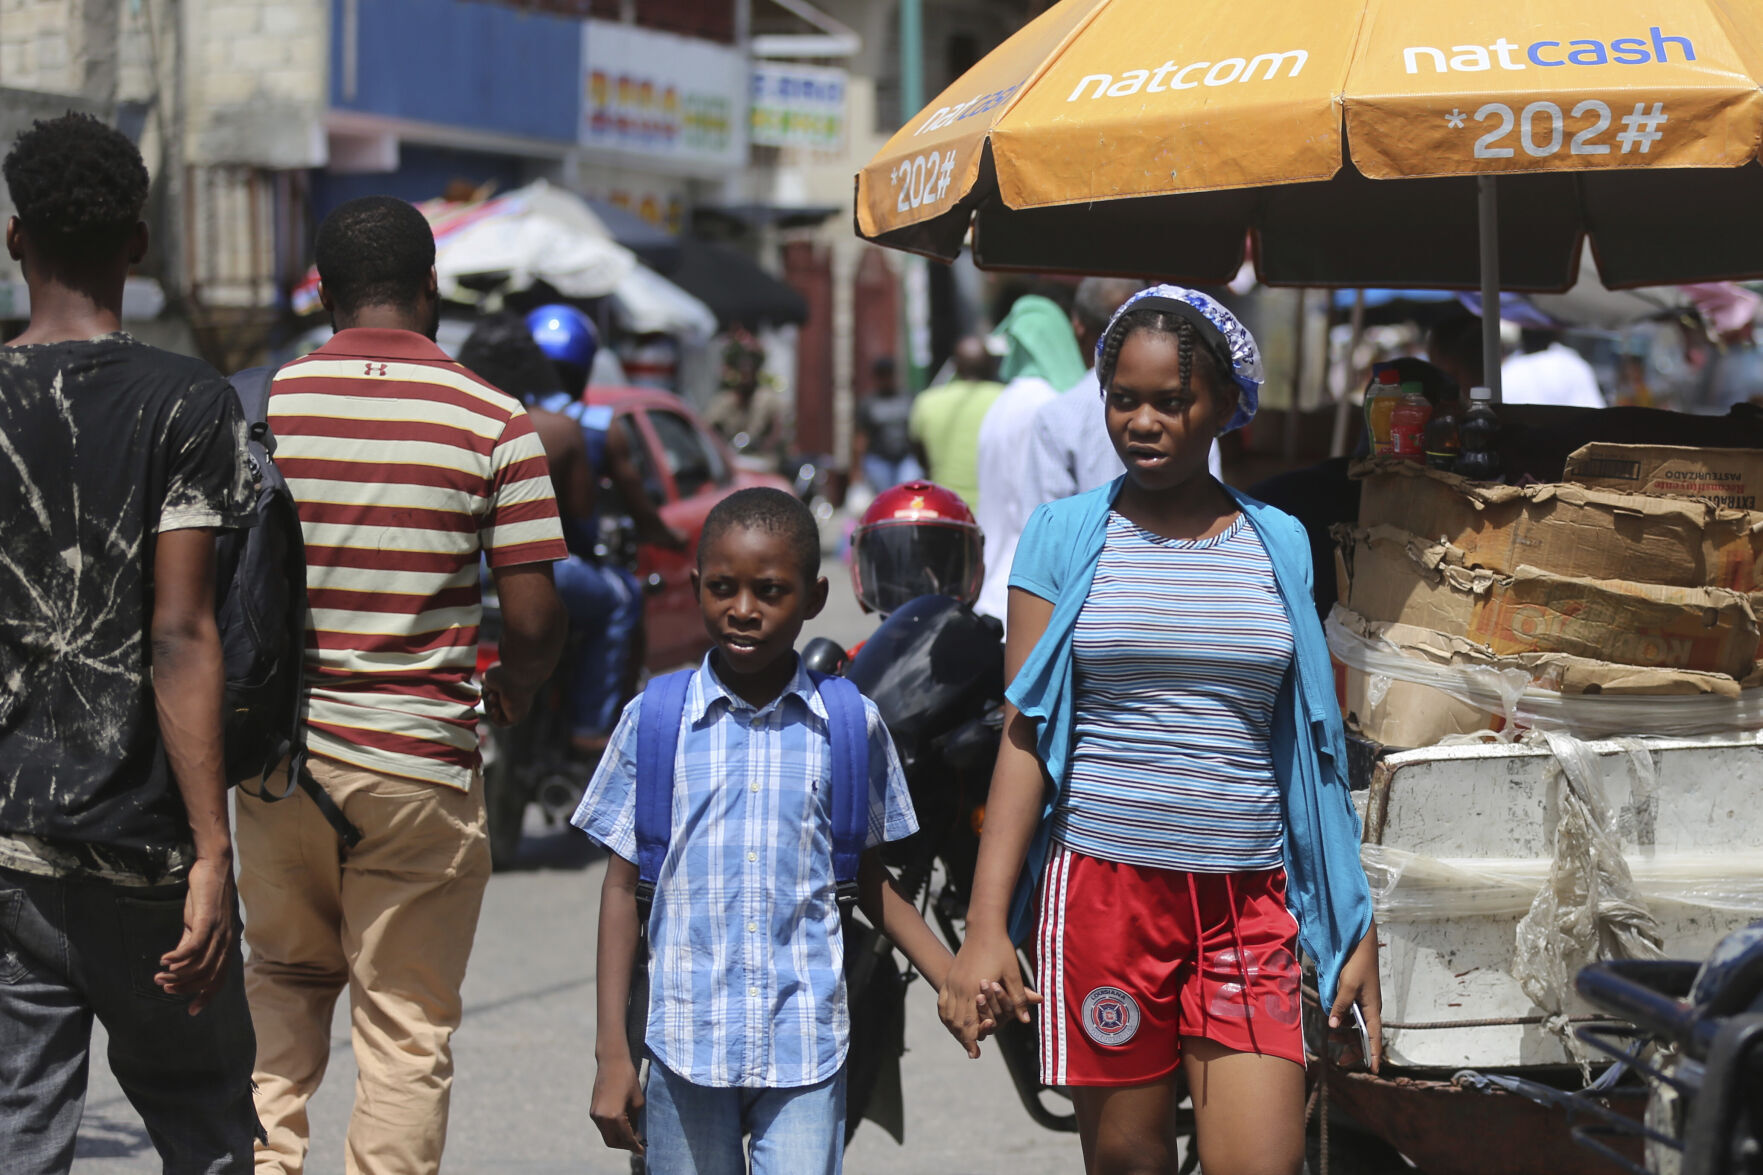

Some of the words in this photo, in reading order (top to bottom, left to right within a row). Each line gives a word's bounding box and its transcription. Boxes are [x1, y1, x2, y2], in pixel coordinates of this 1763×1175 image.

[1402, 27, 1696, 74] natcash
[1066, 50, 1309, 102] natcom
[1665, 470, 1742, 481] PASTEURIZADO
[1090, 989, 1126, 1001] LOUISIANA
